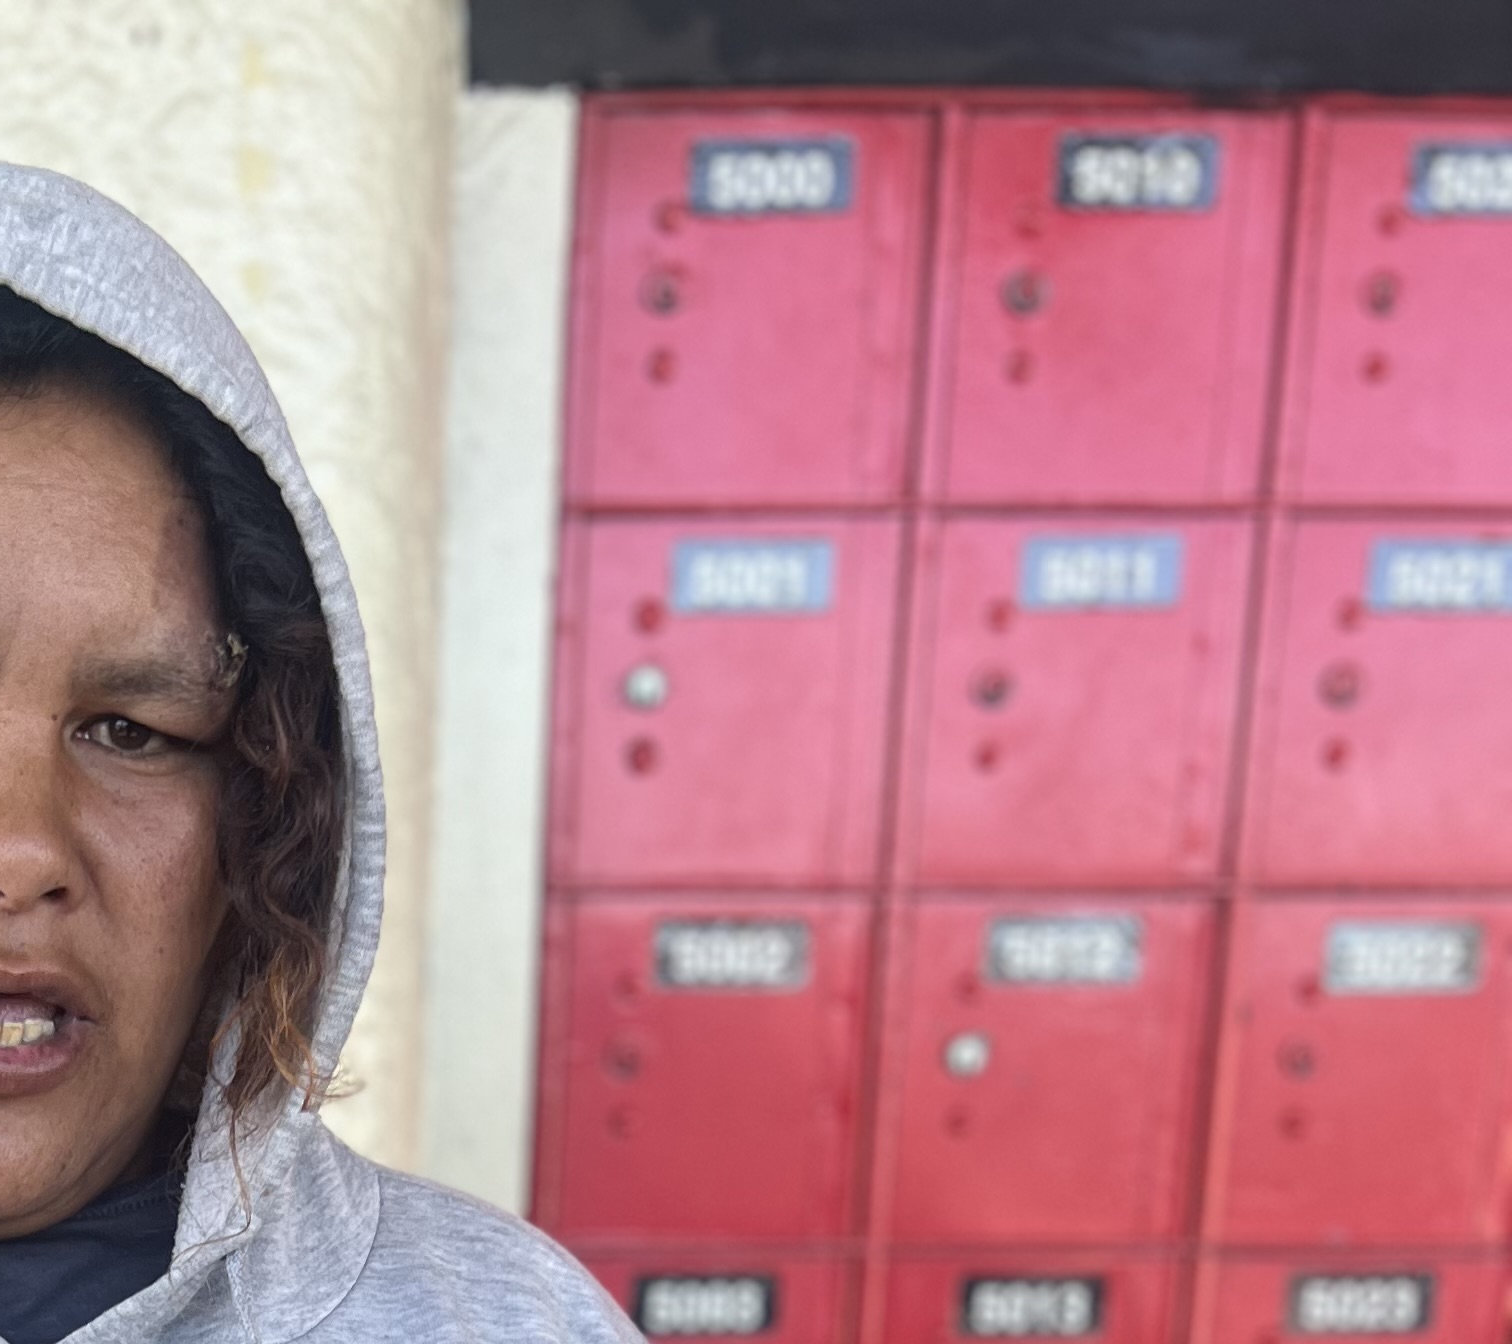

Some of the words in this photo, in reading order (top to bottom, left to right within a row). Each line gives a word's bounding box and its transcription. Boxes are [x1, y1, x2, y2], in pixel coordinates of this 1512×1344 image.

[706, 151, 835, 209] 5000
[1073, 147, 1201, 206] 5010
[1039, 544, 1159, 602] 5011
